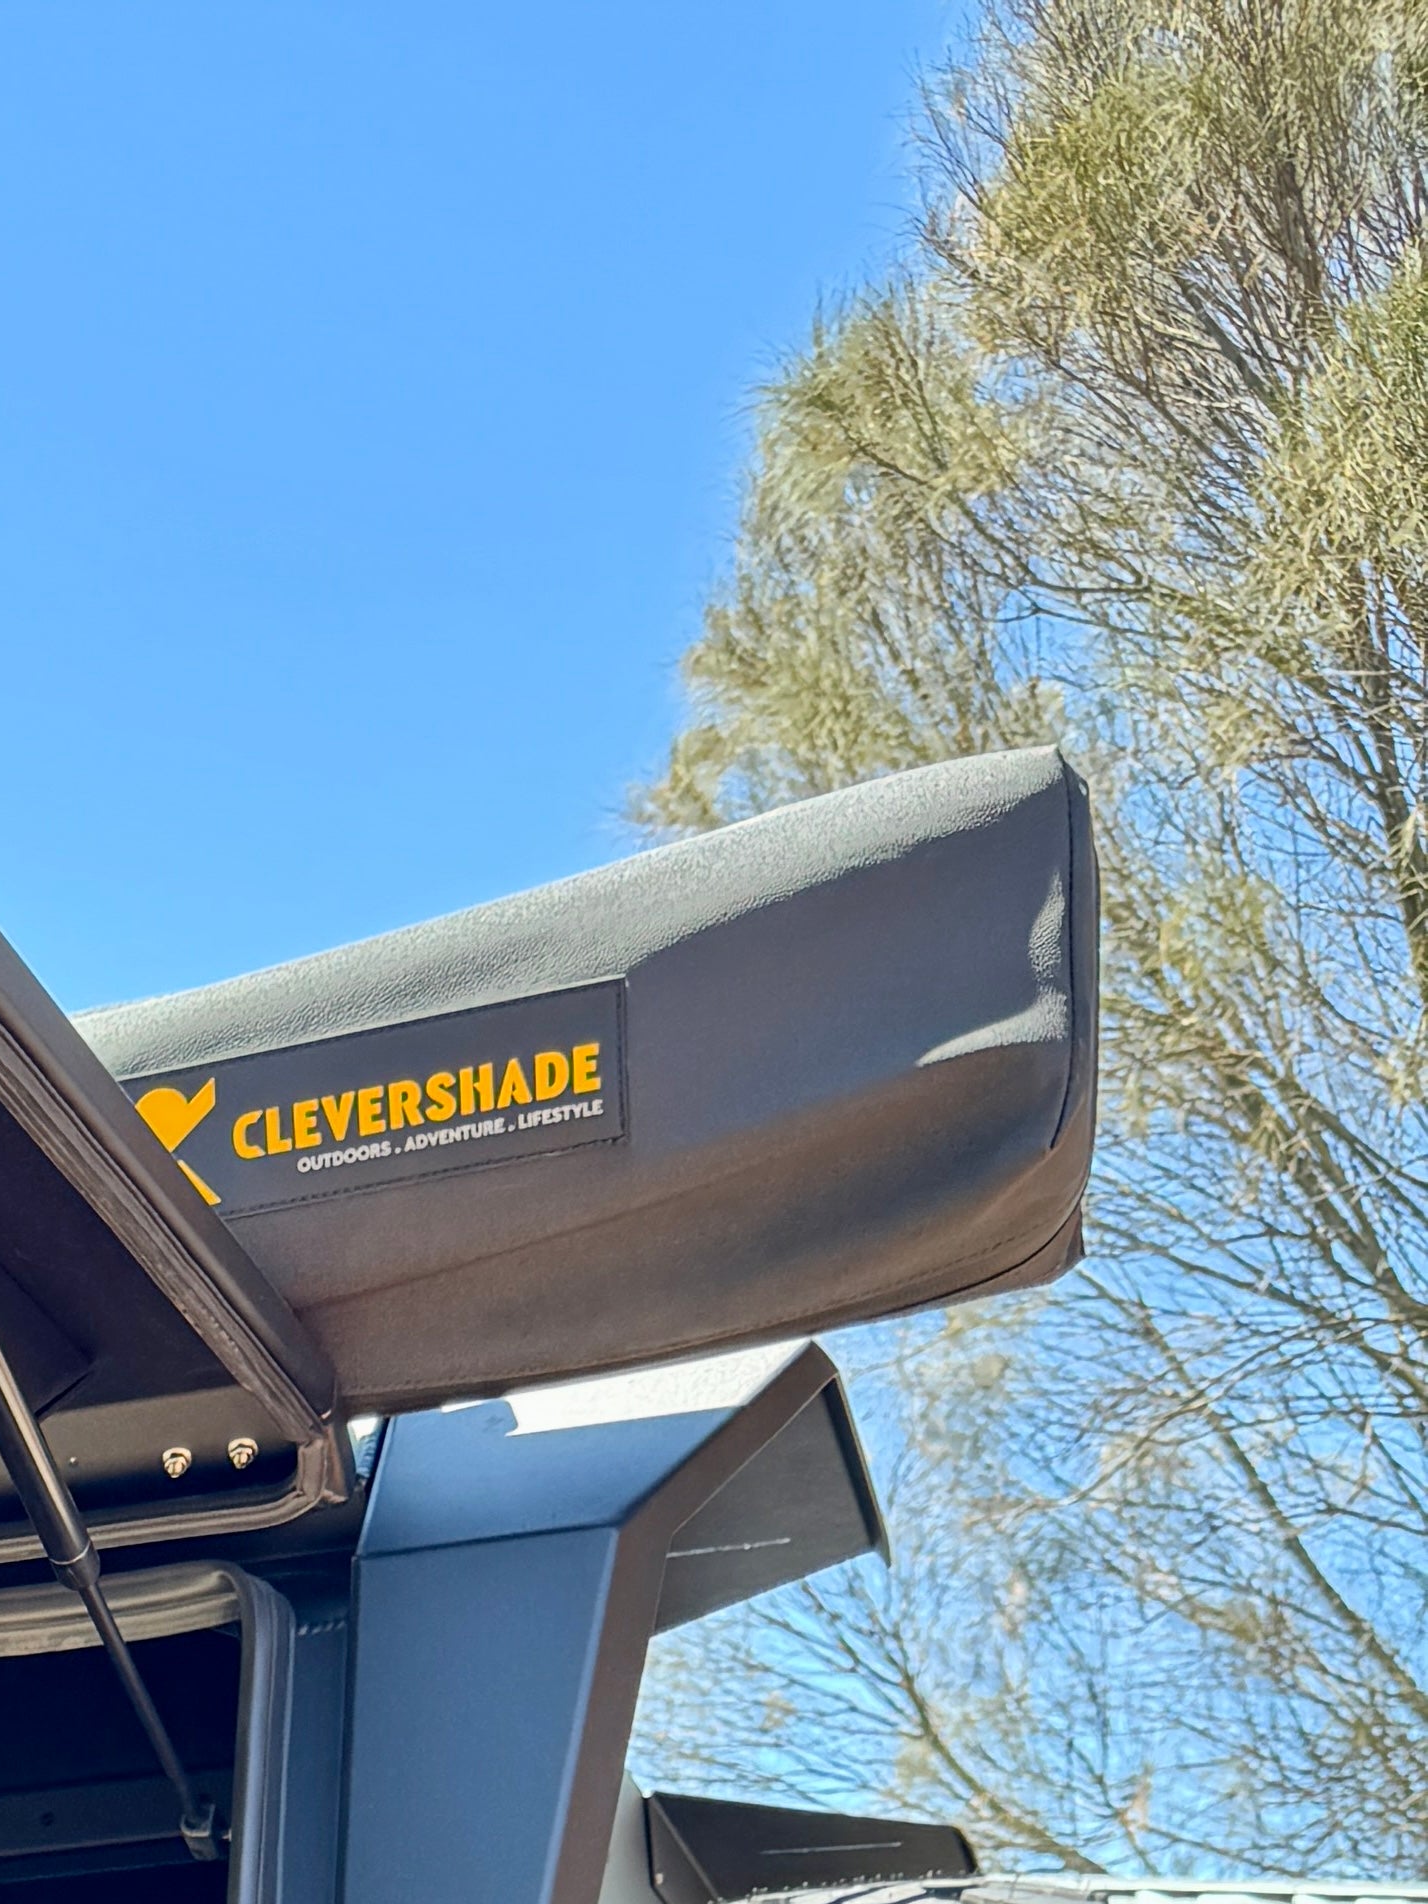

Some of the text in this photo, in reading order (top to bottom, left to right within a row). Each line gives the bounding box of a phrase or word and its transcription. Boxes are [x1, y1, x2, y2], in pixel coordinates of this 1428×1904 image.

[232, 1041, 602, 1160] CLEVERSHADE
[296, 1098, 605, 1174] OUTDOORS ADVENTURE LIFESTYLE
